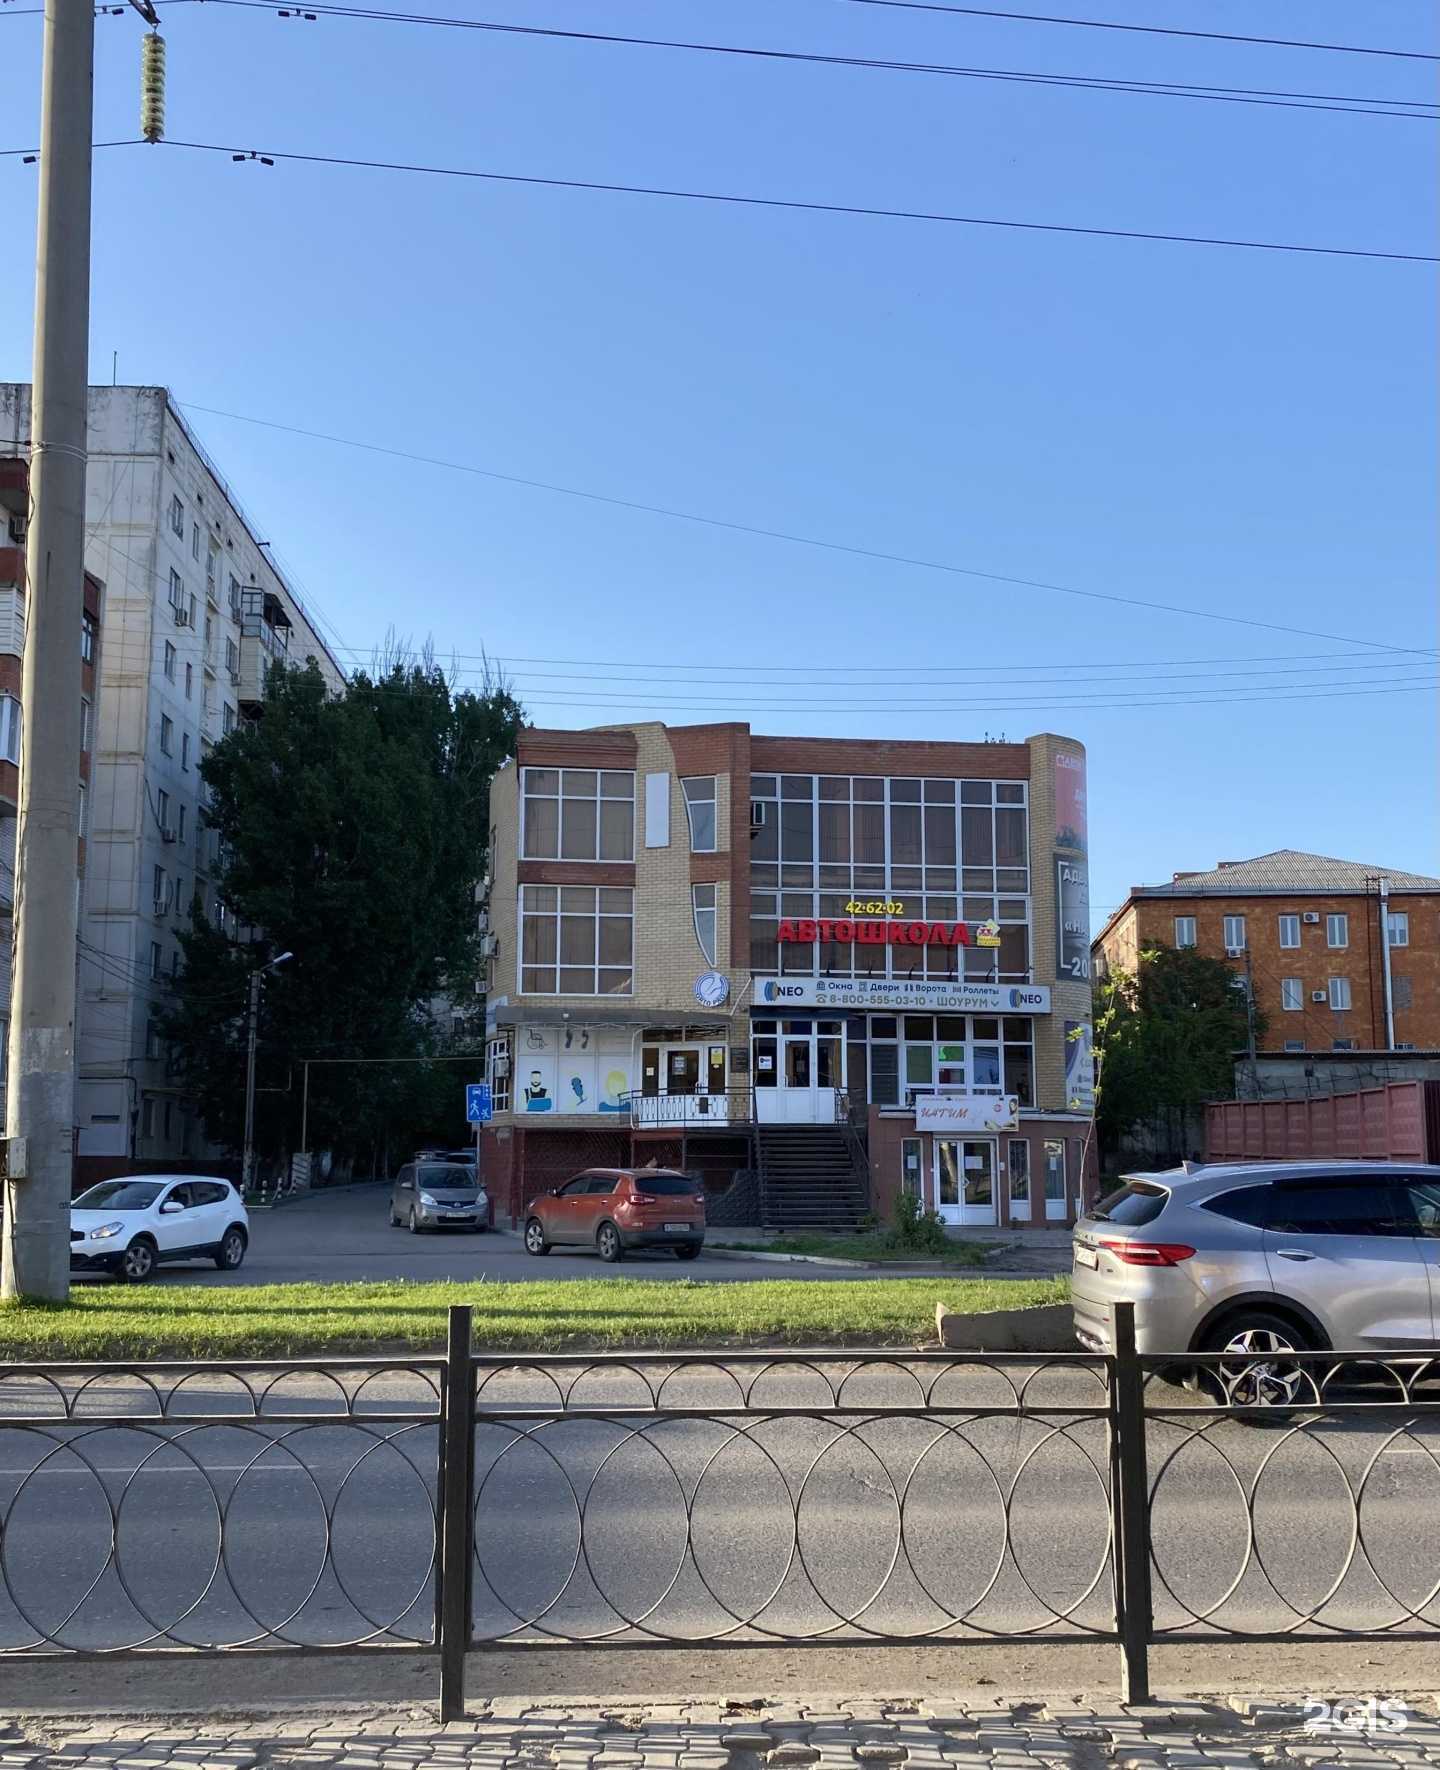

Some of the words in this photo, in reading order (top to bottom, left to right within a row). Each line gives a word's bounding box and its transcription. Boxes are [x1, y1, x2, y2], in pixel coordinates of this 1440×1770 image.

[776, 919, 970, 945] АВТОШКОЛА
[777, 986, 804, 997] NEO
[828, 982, 853, 990] Окна
[870, 983, 900, 992] Двери
[916, 984, 947, 994] Ворота
[963, 985, 1000, 995] Роллеты
[937, 996, 988, 1008] ШОУРУМ
[1020, 994, 1042, 1004] NEO
